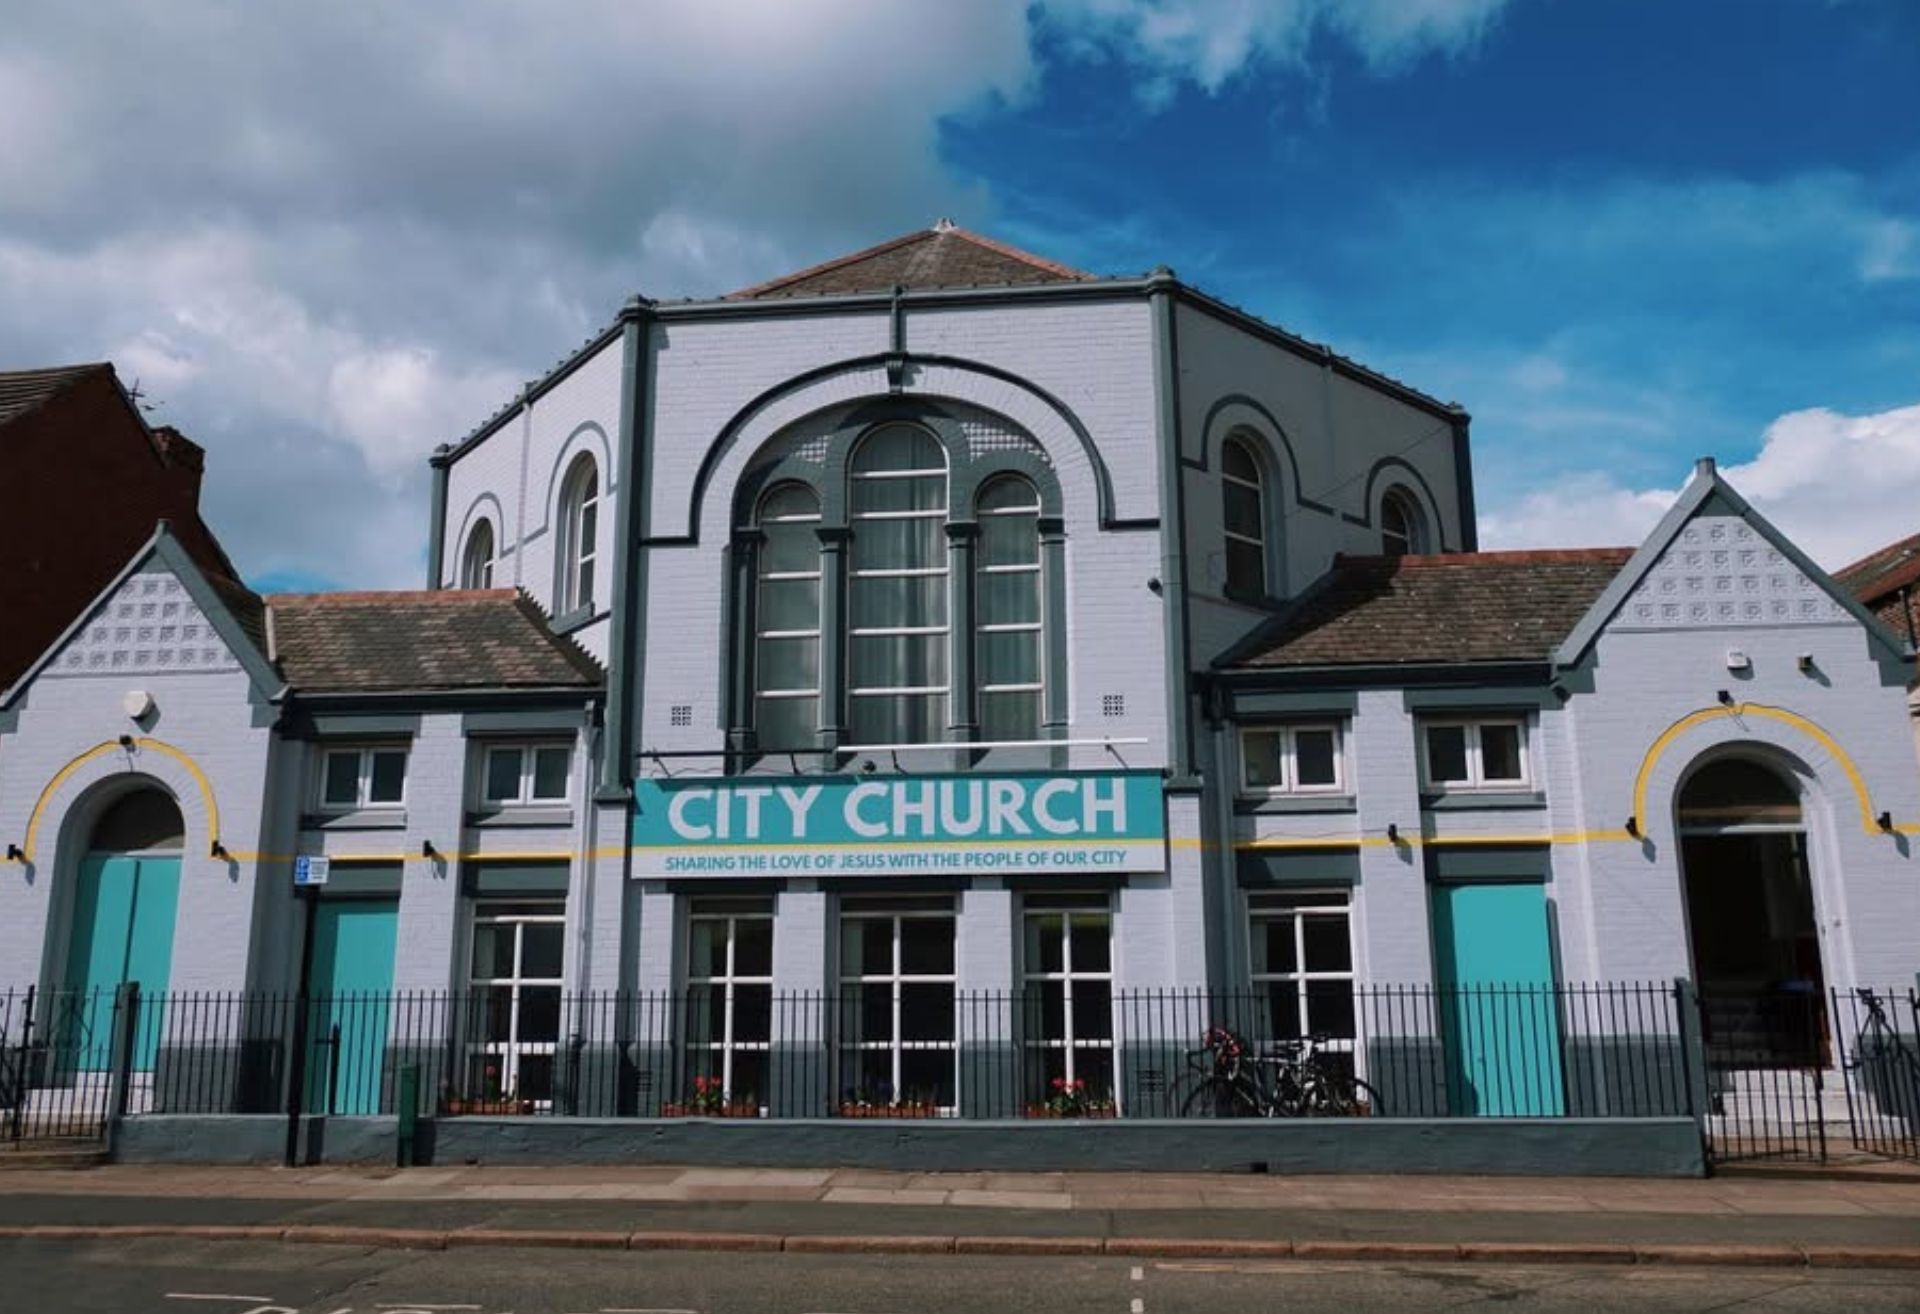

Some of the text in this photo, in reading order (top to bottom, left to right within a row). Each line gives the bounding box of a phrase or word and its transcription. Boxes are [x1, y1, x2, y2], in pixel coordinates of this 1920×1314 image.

[668, 778, 1126, 839] CITY CHURCH
[666, 850, 1127, 871] SHARING THE LOVE OF JESUS WITH THE PEOPLE OF OUR CITY
